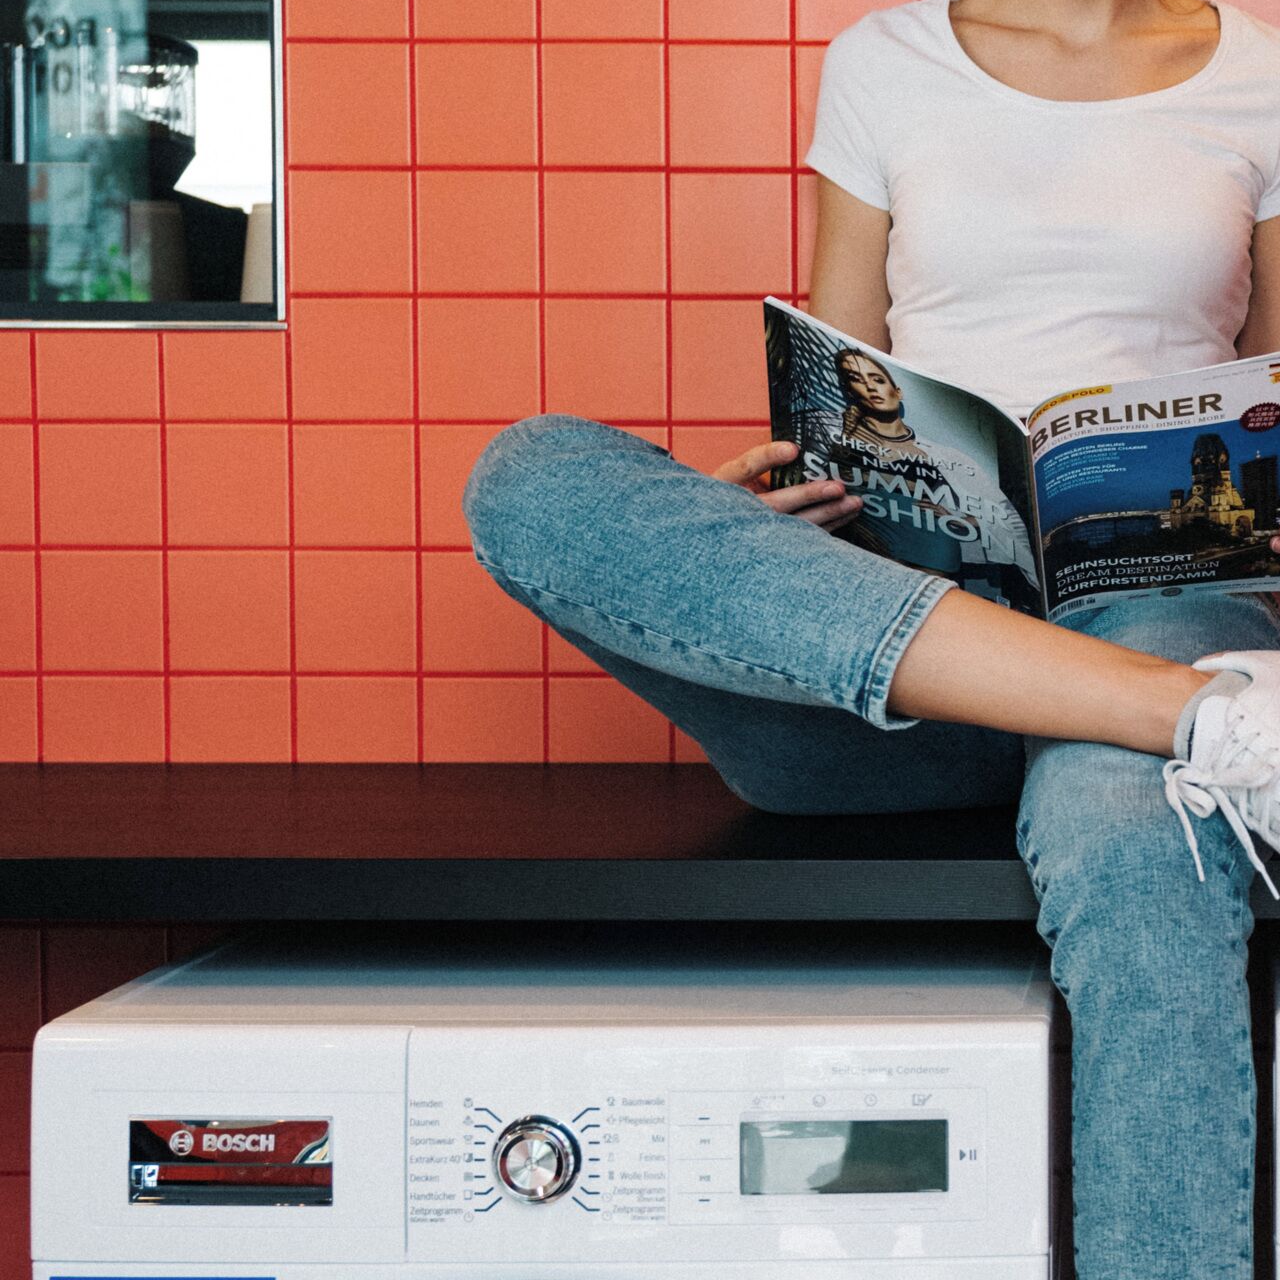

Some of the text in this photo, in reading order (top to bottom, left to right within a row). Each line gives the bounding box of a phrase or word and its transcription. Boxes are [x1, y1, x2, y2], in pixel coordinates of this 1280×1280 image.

[1071, 388, 1105, 398] POLO
[1032, 393, 1223, 454] BERLINER
[1100, 423, 1149, 432] SHOPPING
[1156, 419, 1191, 428] DINING
[1198, 414, 1226, 423] MORE
[830, 431, 892, 457] CHECK
[863, 456, 944, 481] NEW IN:
[803, 451, 1013, 532] SUMMER
[861, 493, 1017, 563] SHION
[1055, 553, 1194, 579] SEHNSUCHTSORT
[1056, 560, 1220, 588] DREAM DESTINATION
[1057, 570, 1217, 598] KURFÜRSTENDAMM
[896, 1065, 950, 1075] Condenser
[202, 1134, 275, 1153] BOSCH
